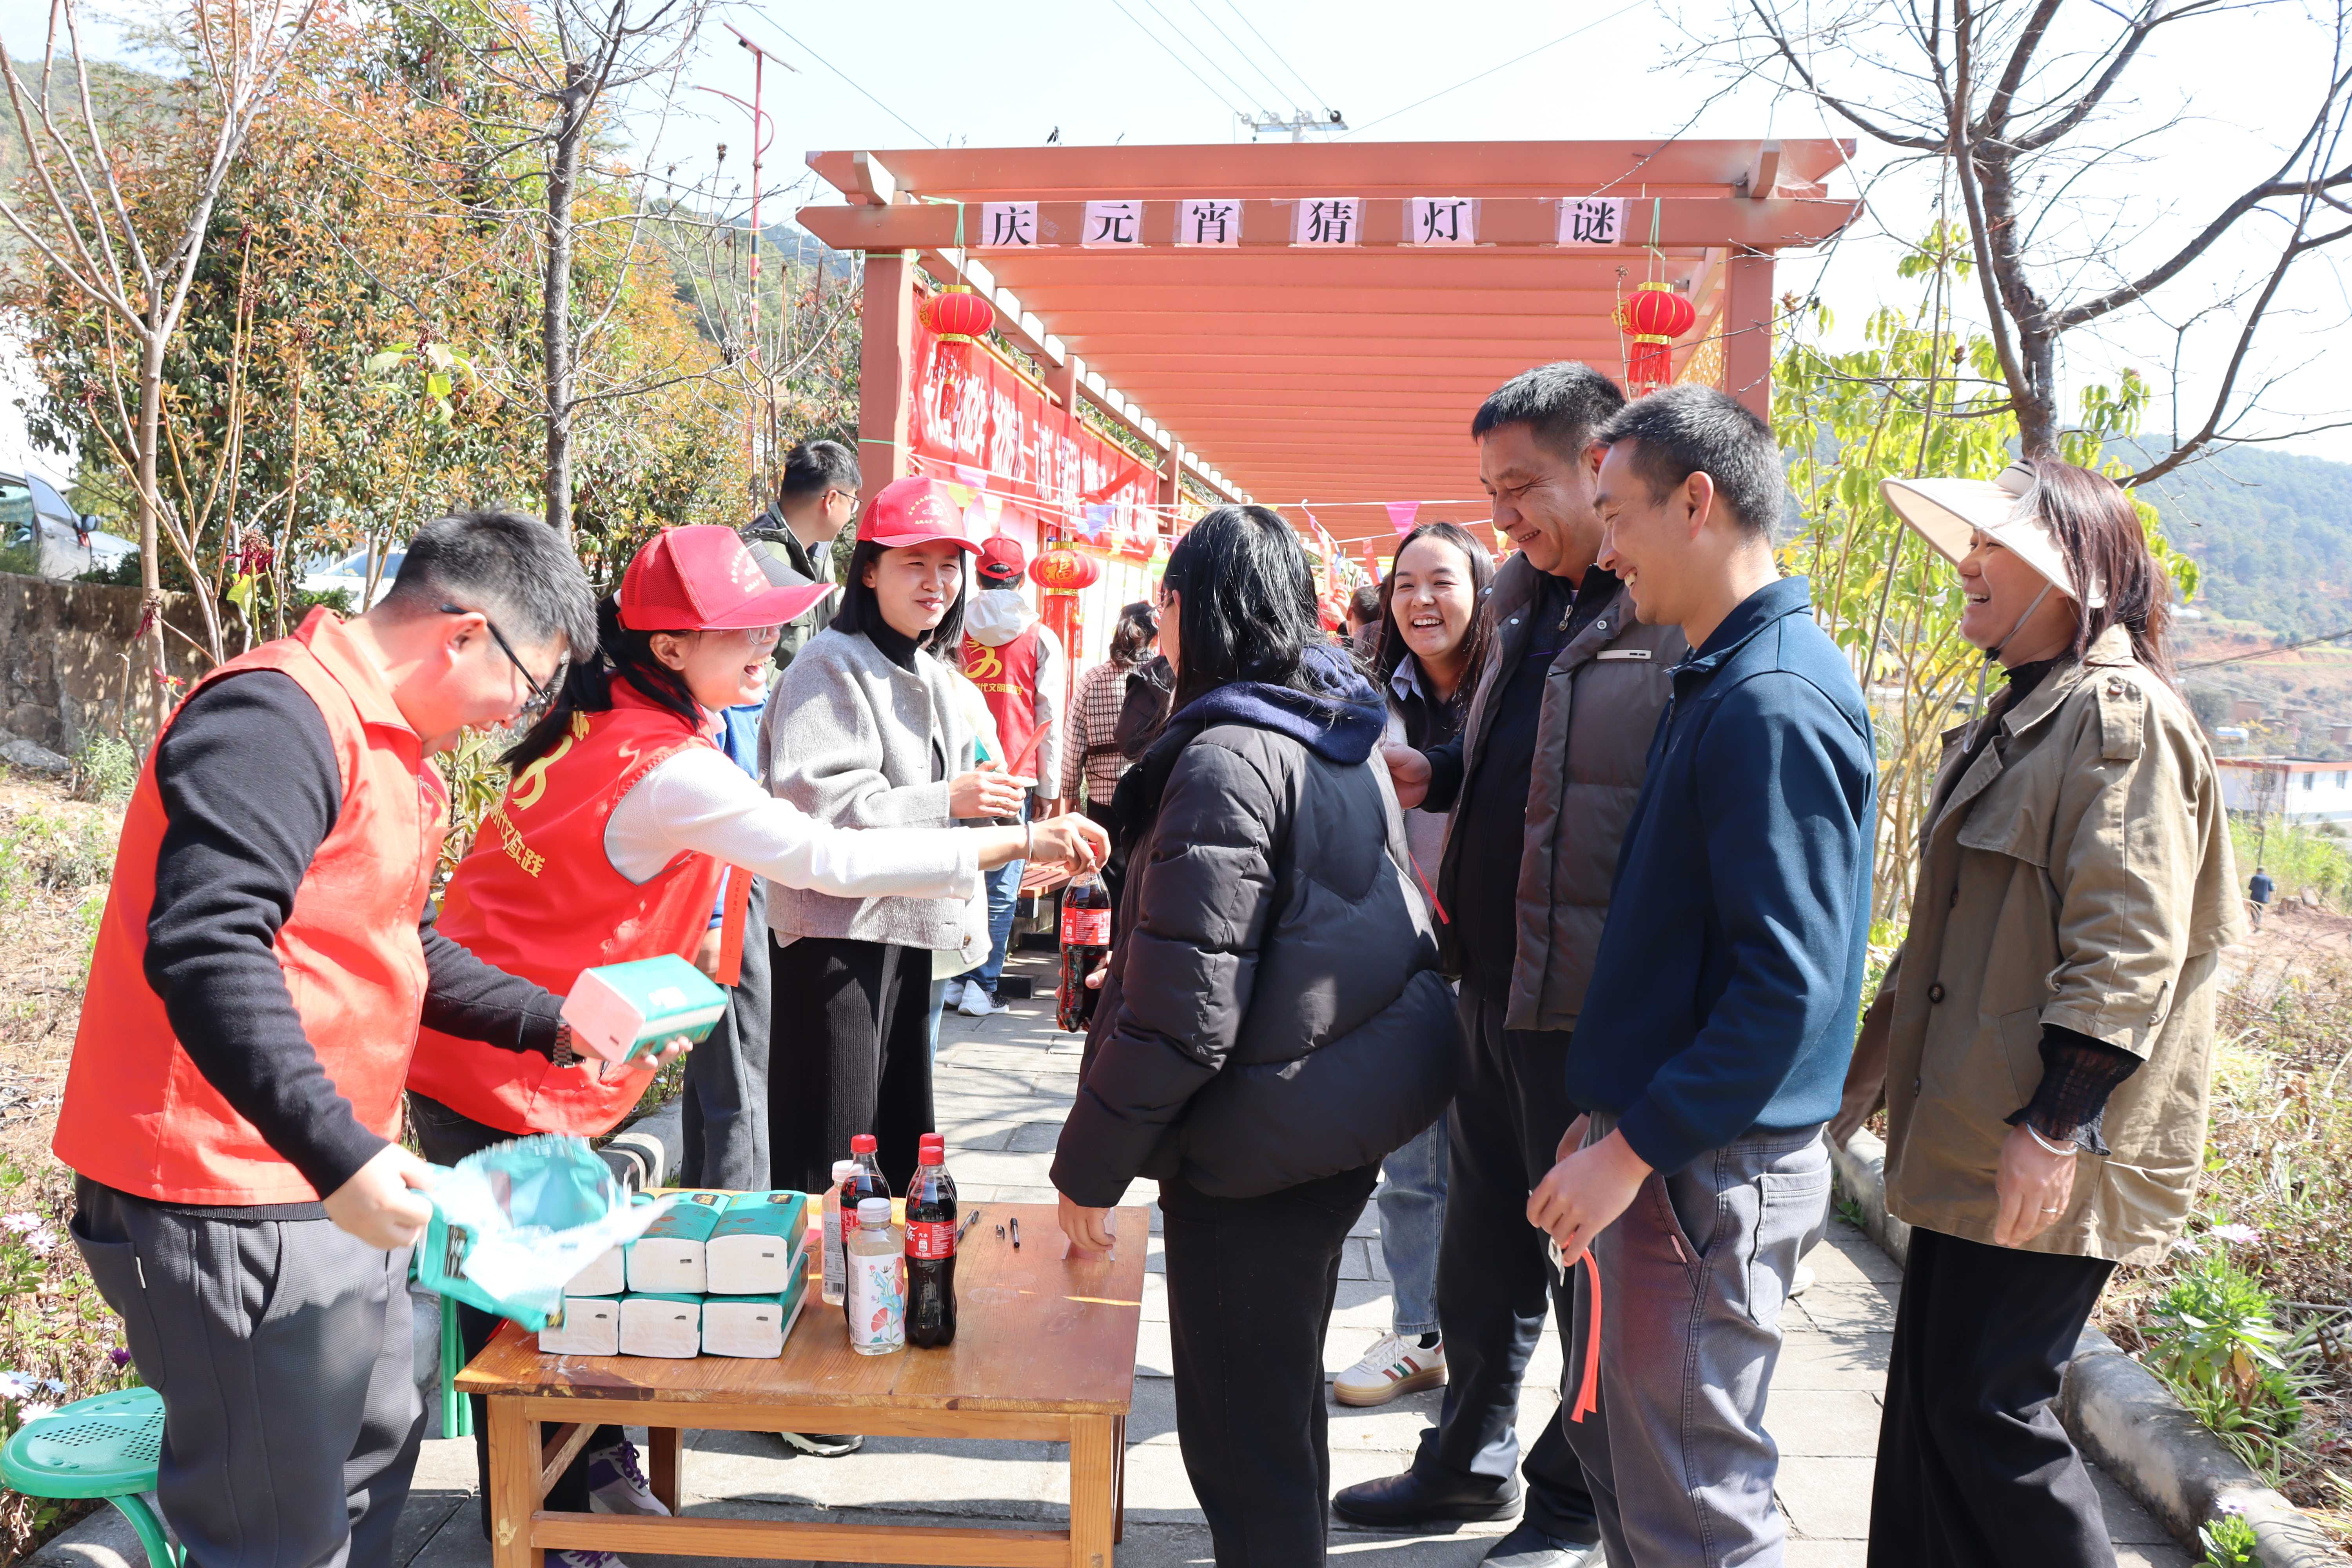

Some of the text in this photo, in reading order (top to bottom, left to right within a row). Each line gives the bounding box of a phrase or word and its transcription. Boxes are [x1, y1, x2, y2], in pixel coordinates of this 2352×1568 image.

[993, 201, 1615, 246] 庆元宵猜灯谜
[976, 683, 1023, 696] 代文明实践
